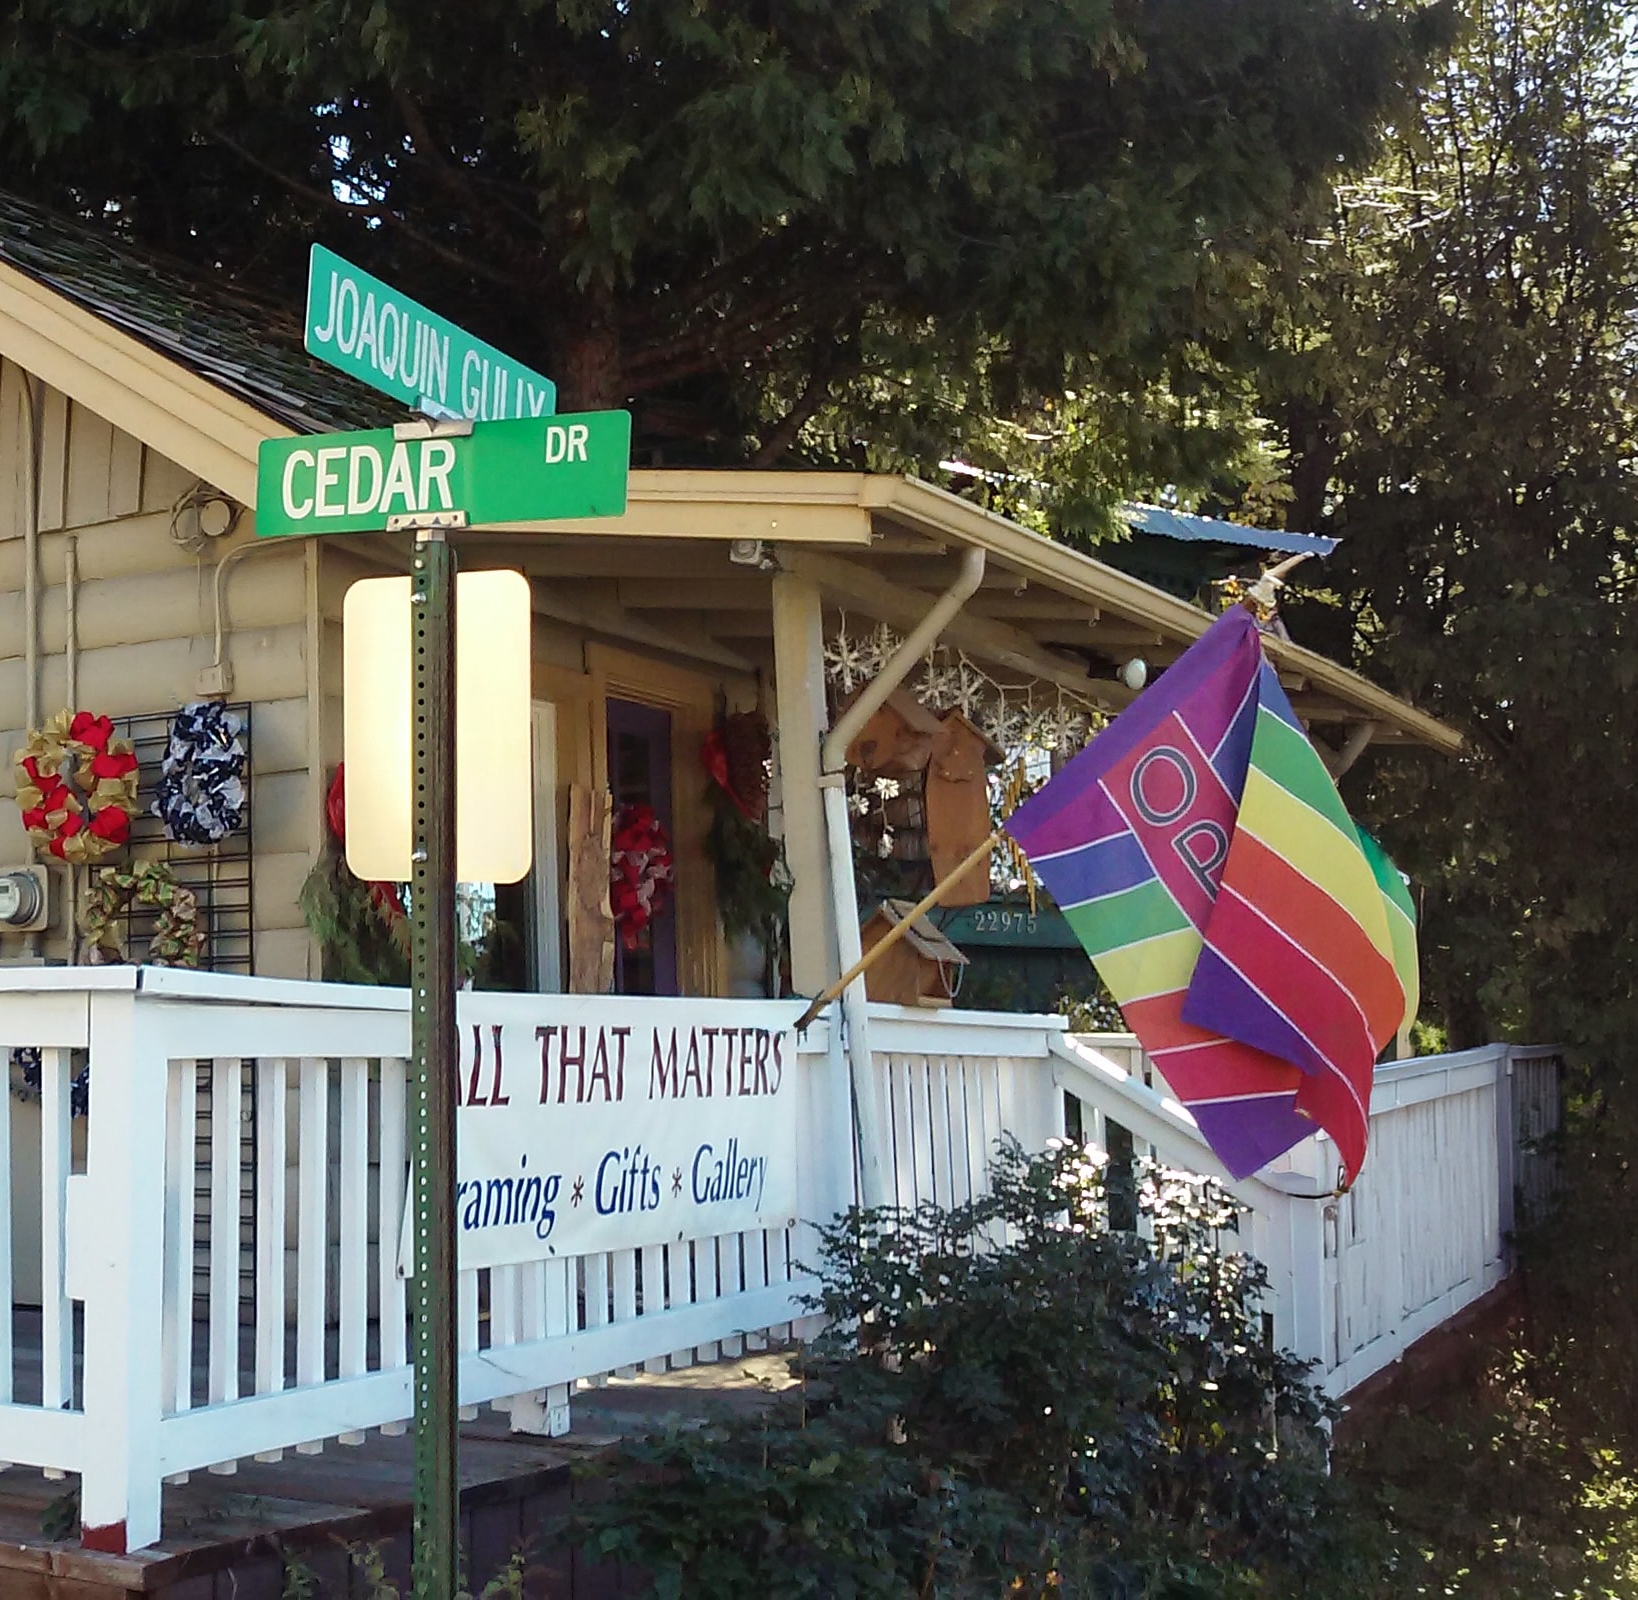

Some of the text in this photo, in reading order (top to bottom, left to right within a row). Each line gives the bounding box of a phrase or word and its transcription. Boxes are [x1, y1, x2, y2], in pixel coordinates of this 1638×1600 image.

[314, 270, 450, 403] JOAQUIN
[282, 424, 589, 520] CEDAR DR
[974, 910, 1037, 934] 22975
[455, 1023, 786, 1107] LL THAT MATTERS
[455, 1138, 768, 1239] raming Gifts Gallery
